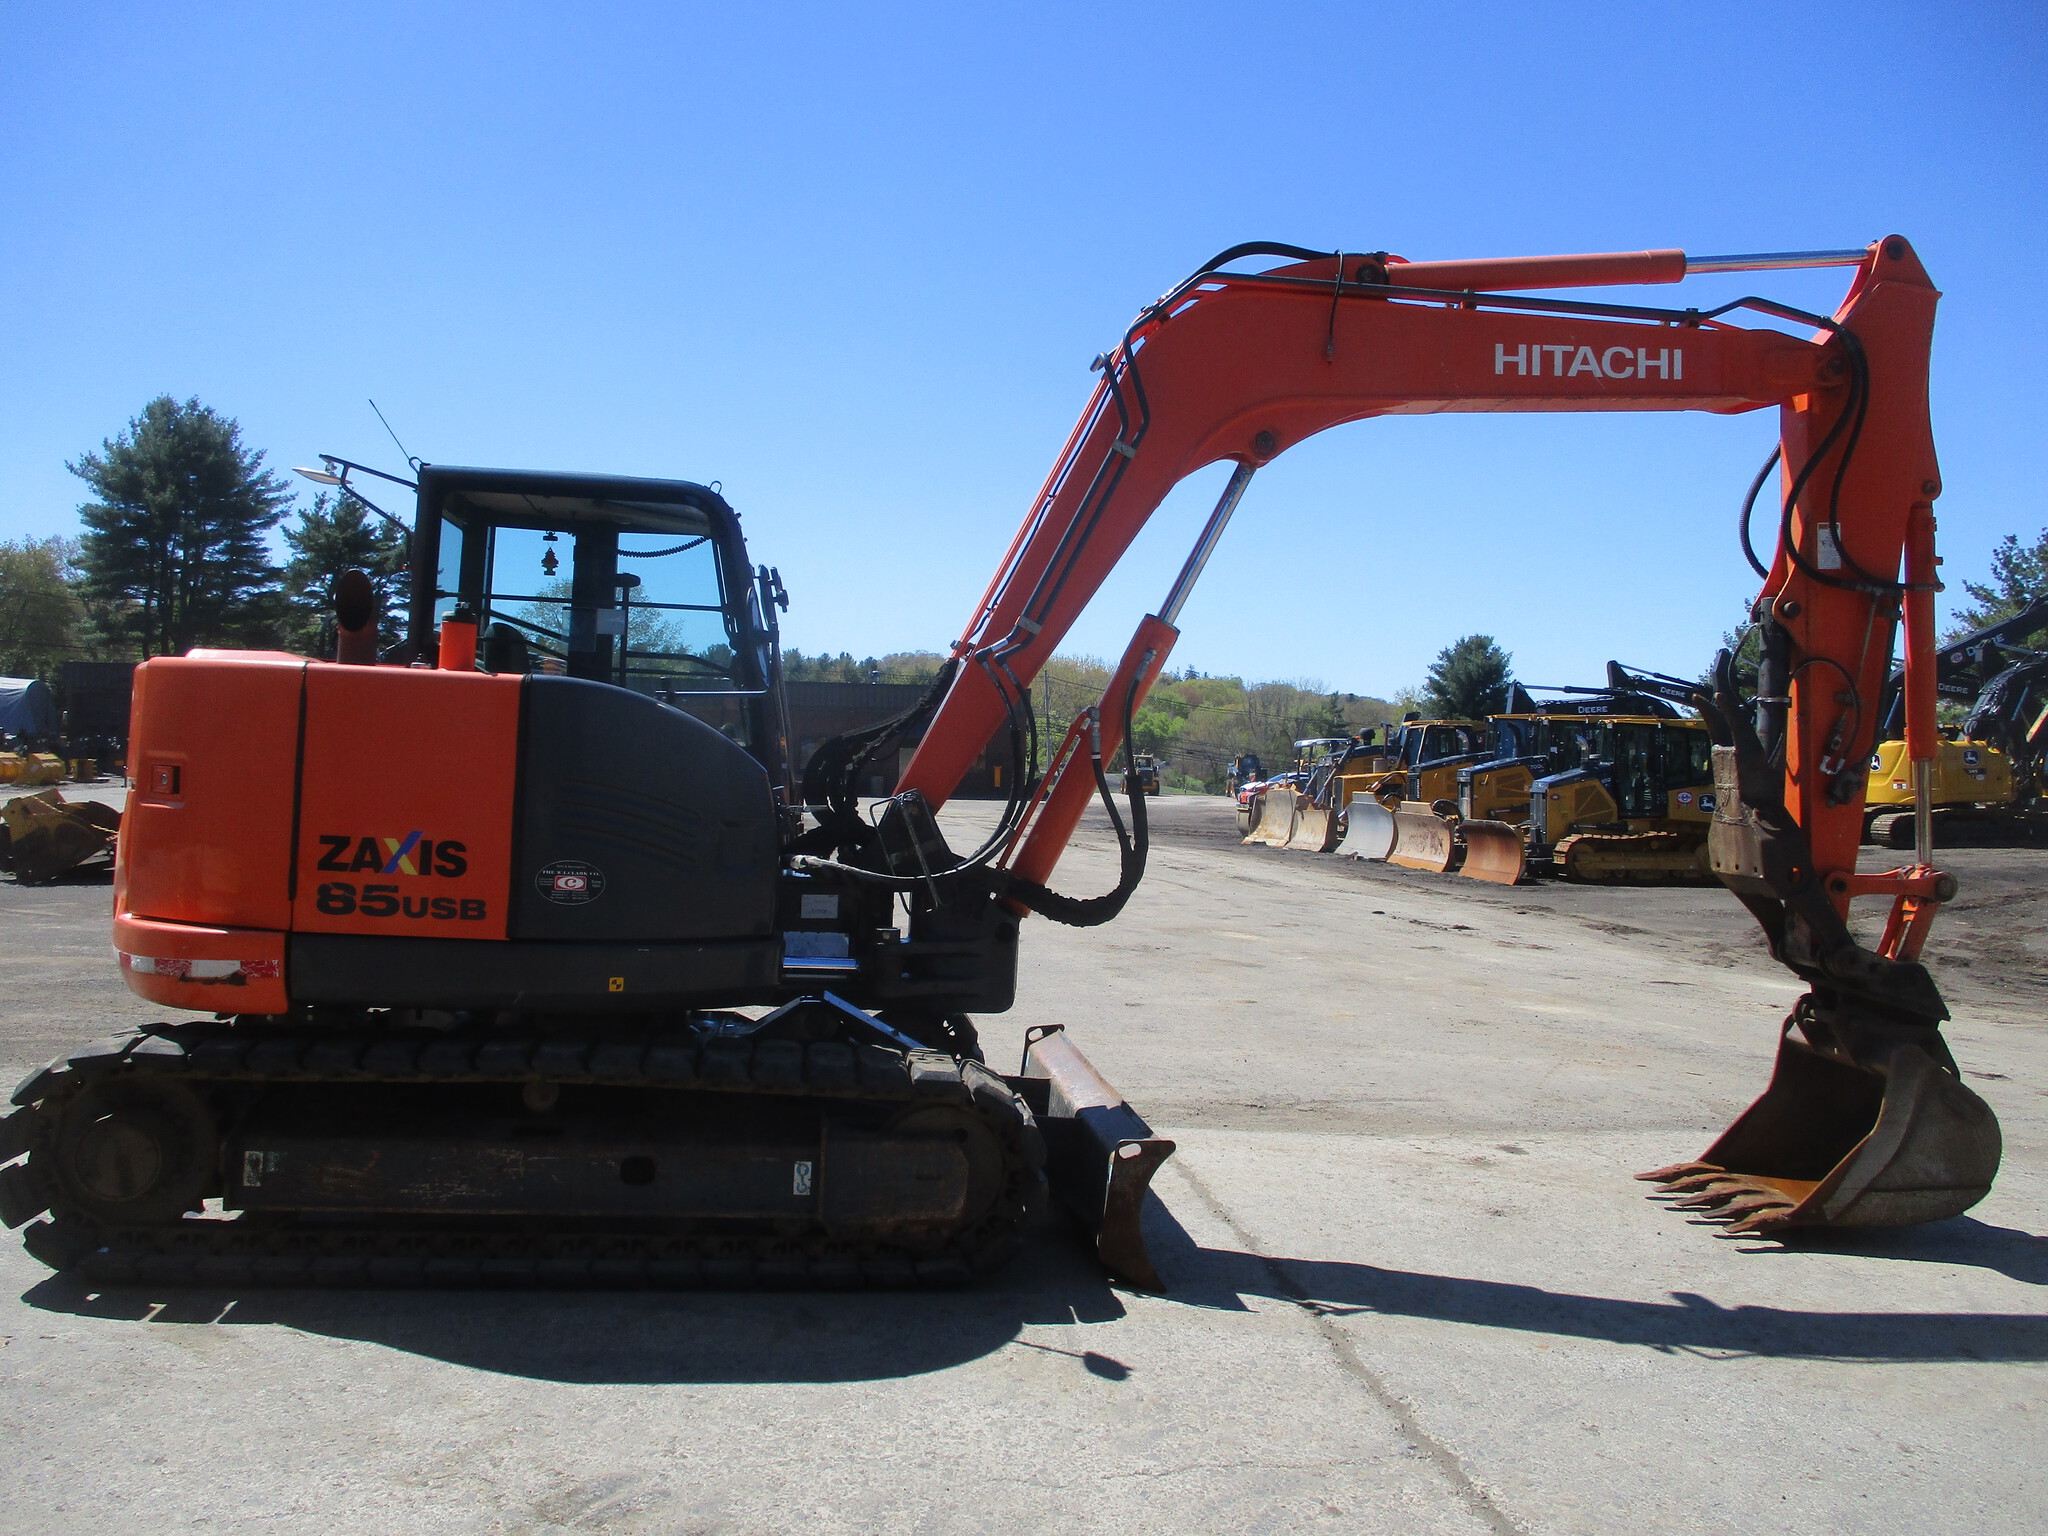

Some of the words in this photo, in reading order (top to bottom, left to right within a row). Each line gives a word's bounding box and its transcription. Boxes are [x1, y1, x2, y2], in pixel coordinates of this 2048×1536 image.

[1495, 343, 1682, 380] HITACHI
[1659, 686, 1686, 698] DEERE
[1938, 682, 1969, 694] DEERE
[1577, 705, 1609, 714] DEERE
[317, 830, 468, 878] ZAXIS
